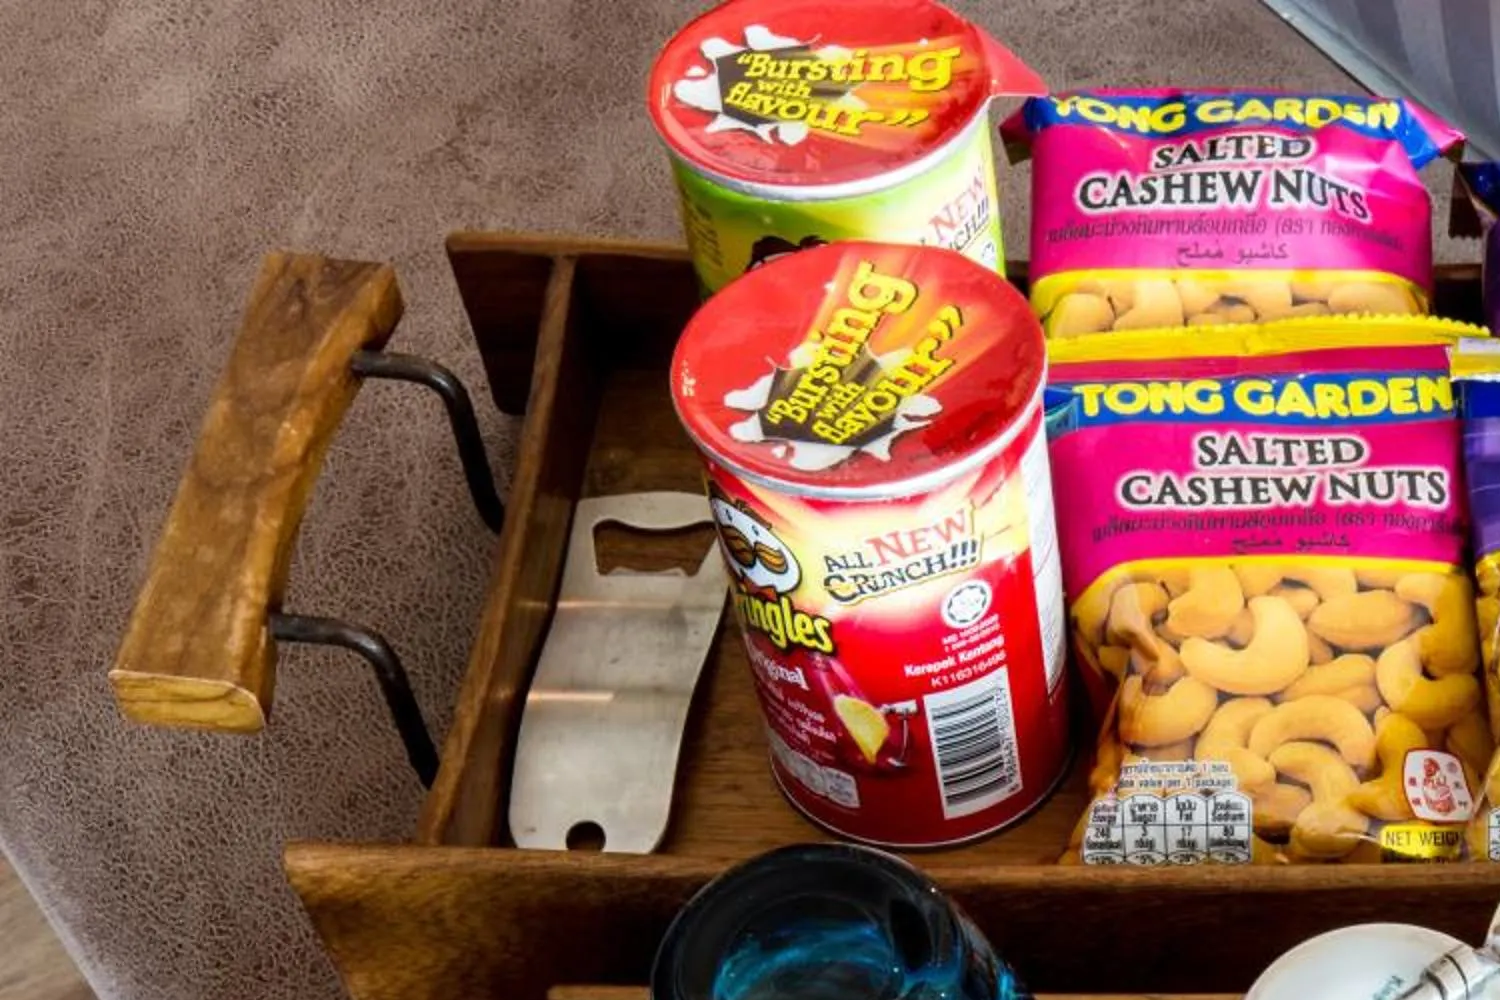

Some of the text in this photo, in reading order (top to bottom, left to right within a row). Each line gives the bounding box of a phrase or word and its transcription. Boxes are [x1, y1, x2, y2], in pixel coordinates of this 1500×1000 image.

[757, 80, 811, 98] with
[1052, 96, 1400, 132] TONG GARDEN
[1154, 134, 1311, 168] SALTED
[1080, 170, 1369, 219] CASHEW NUTS
[816, 380, 867, 421] with
[1076, 376, 1453, 418] TONG GARDEN
[1198, 435, 1363, 466] SALTED
[1122, 470, 1447, 505] CASHEW NUTS
[824, 508, 967, 572] ALL NEW
[824, 540, 977, 602] CRUNCH!!!
[1385, 831, 1411, 846] NET
